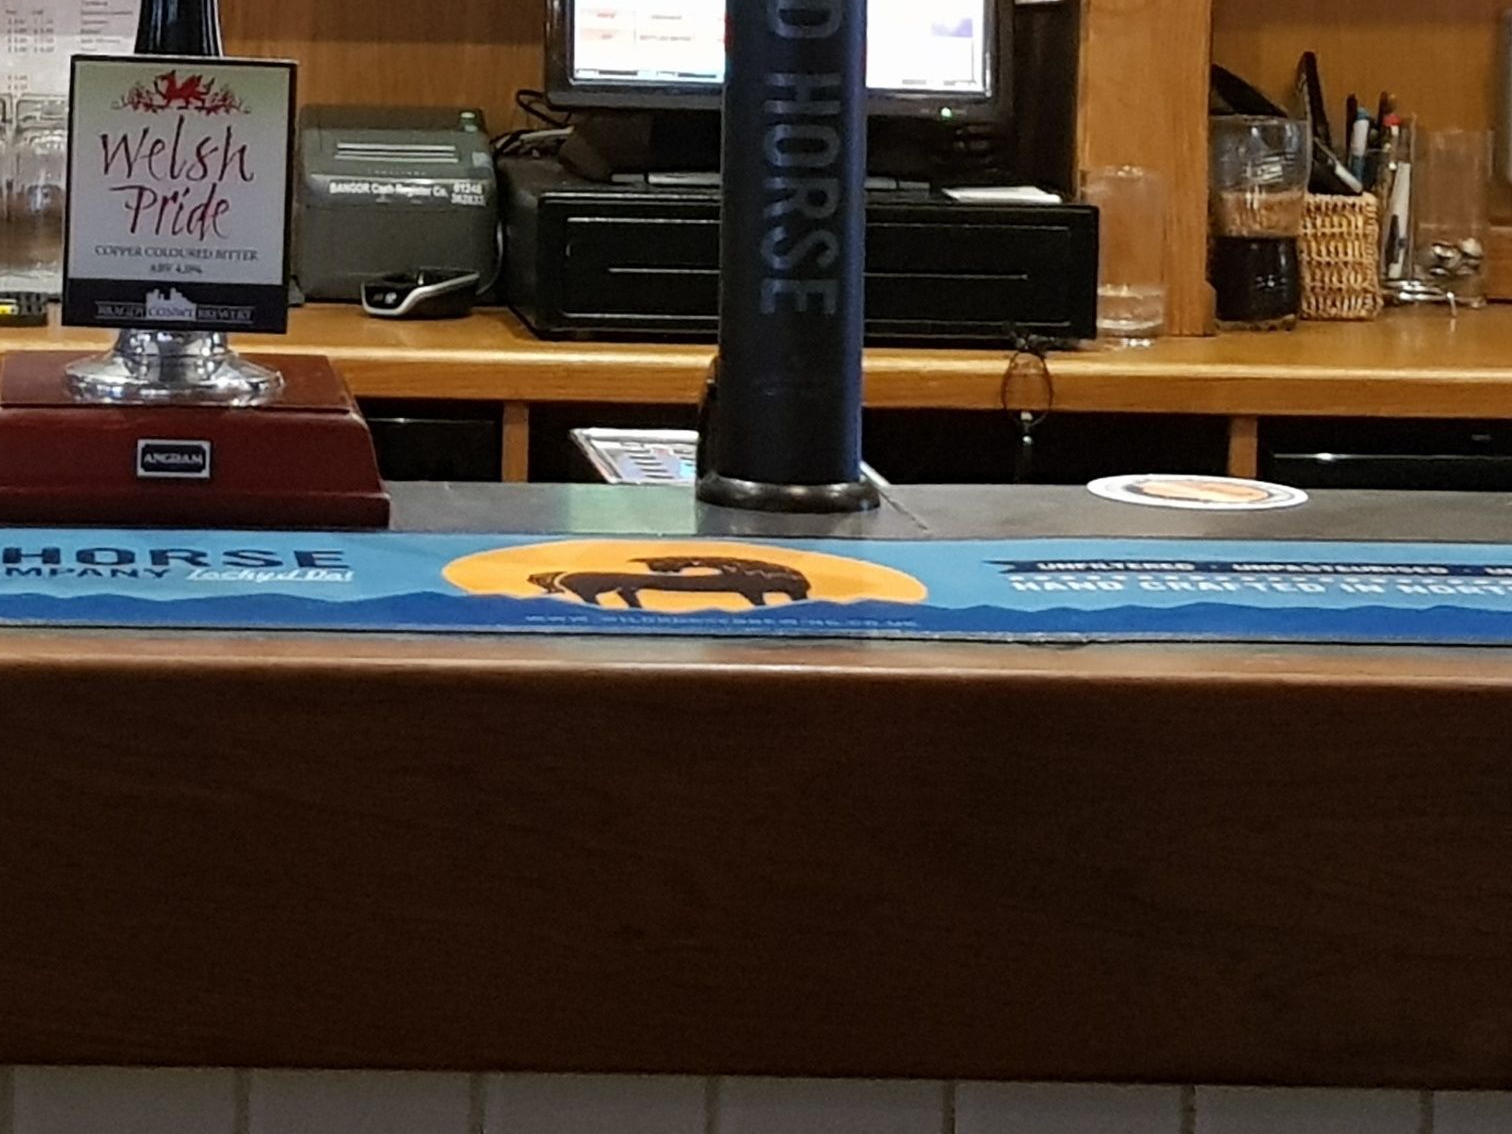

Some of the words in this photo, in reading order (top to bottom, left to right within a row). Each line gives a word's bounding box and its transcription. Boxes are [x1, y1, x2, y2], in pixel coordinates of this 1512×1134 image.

[100, 115, 254, 183] Welsh
[759, 73, 844, 316] HORSE
[109, 182, 231, 241] Pride
[95, 245, 142, 257] COPPER
[144, 246, 213, 259] COLOURED
[215, 248, 258, 261] BITTER
[143, 450, 204, 466] ANGRAM
[1, 546, 350, 569] HORSE
[1037, 562, 1196, 571] UNFILTERED
[1011, 580, 1125, 592] HAND
[1138, 580, 1326, 593] CRAFTED
[1339, 582, 1386, 594] IN
[1396, 584, 1512, 595] NORT
